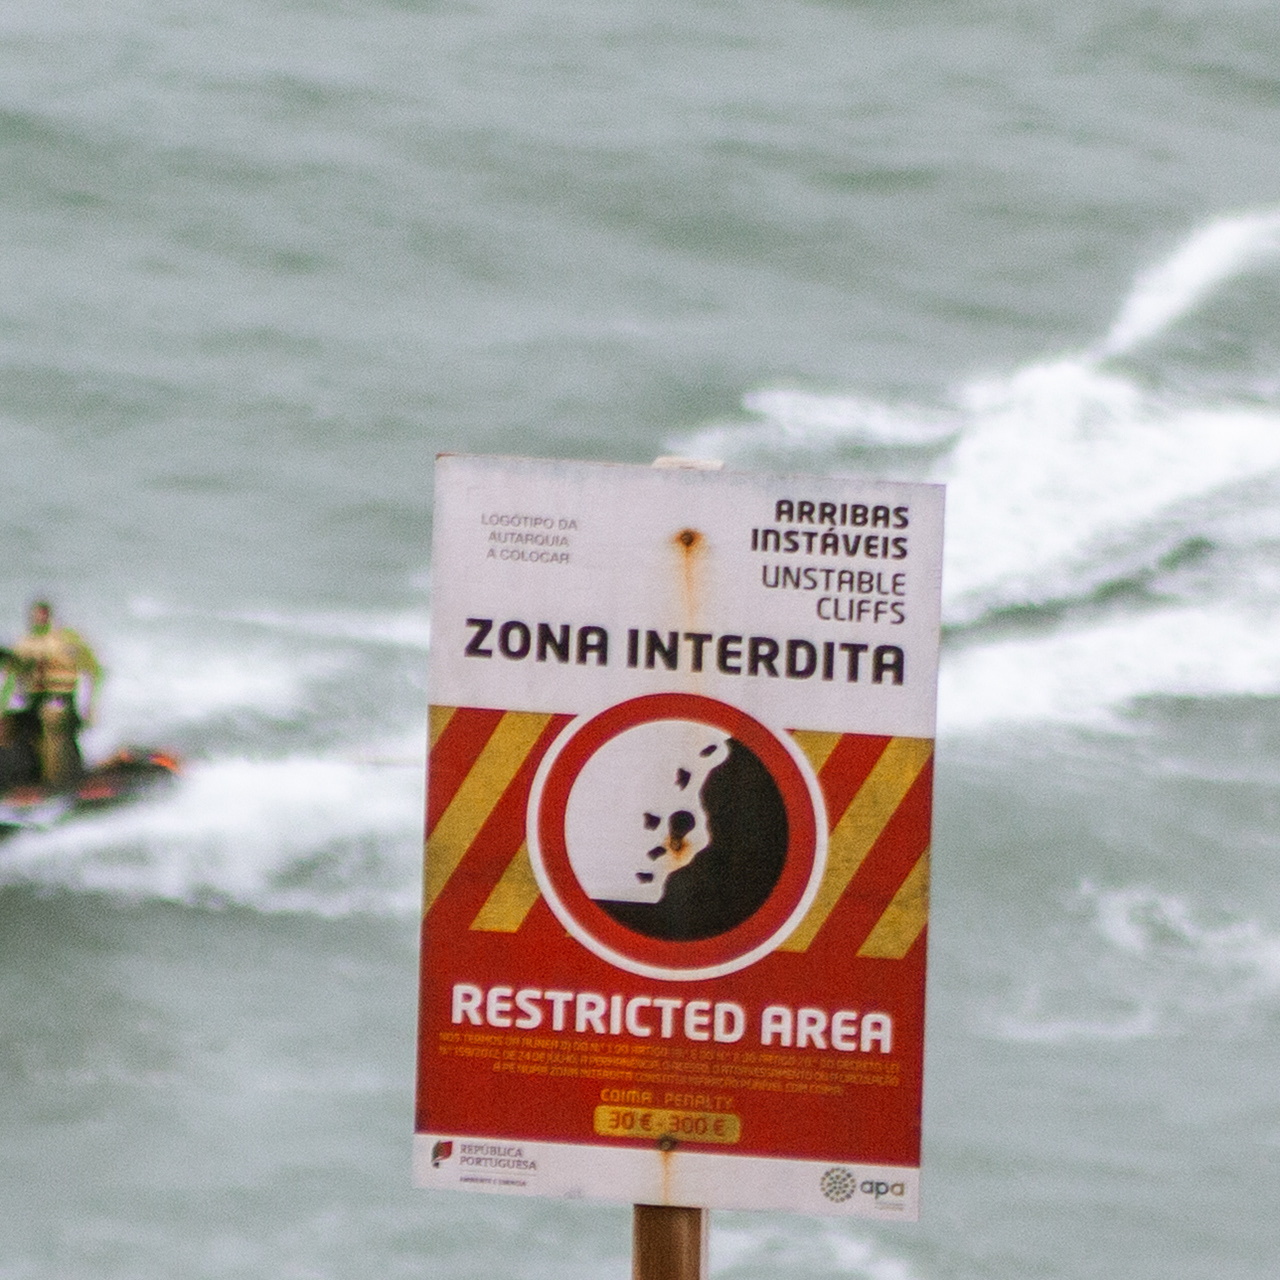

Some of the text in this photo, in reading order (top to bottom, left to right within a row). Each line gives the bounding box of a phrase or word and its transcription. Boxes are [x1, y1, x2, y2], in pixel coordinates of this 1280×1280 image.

[558, 519, 578, 531] DA
[775, 499, 909, 529] ARRIBAS
[488, 531, 570, 547] AUTARQUIA
[751, 527, 908, 560] INSTÁVEIS
[486, 548, 570, 564] A COLOCAR
[762, 565, 906, 596] UNSTABLE
[816, 597, 906, 625] CLIFFS
[463, 617, 905, 686] ZONA INTERDITA
[451, 984, 893, 1055] RESTRICTED AREA
[600, 1088, 735, 1109] COIMA PENALTY
[608, 1110, 635, 1129] 30
[640, 1113, 652, 1131] €
[669, 1115, 707, 1135] 300
[713, 1118, 726, 1136] €
[460, 1156, 537, 1170] PORTUGUESA
[860, 1181, 905, 1200] apa
